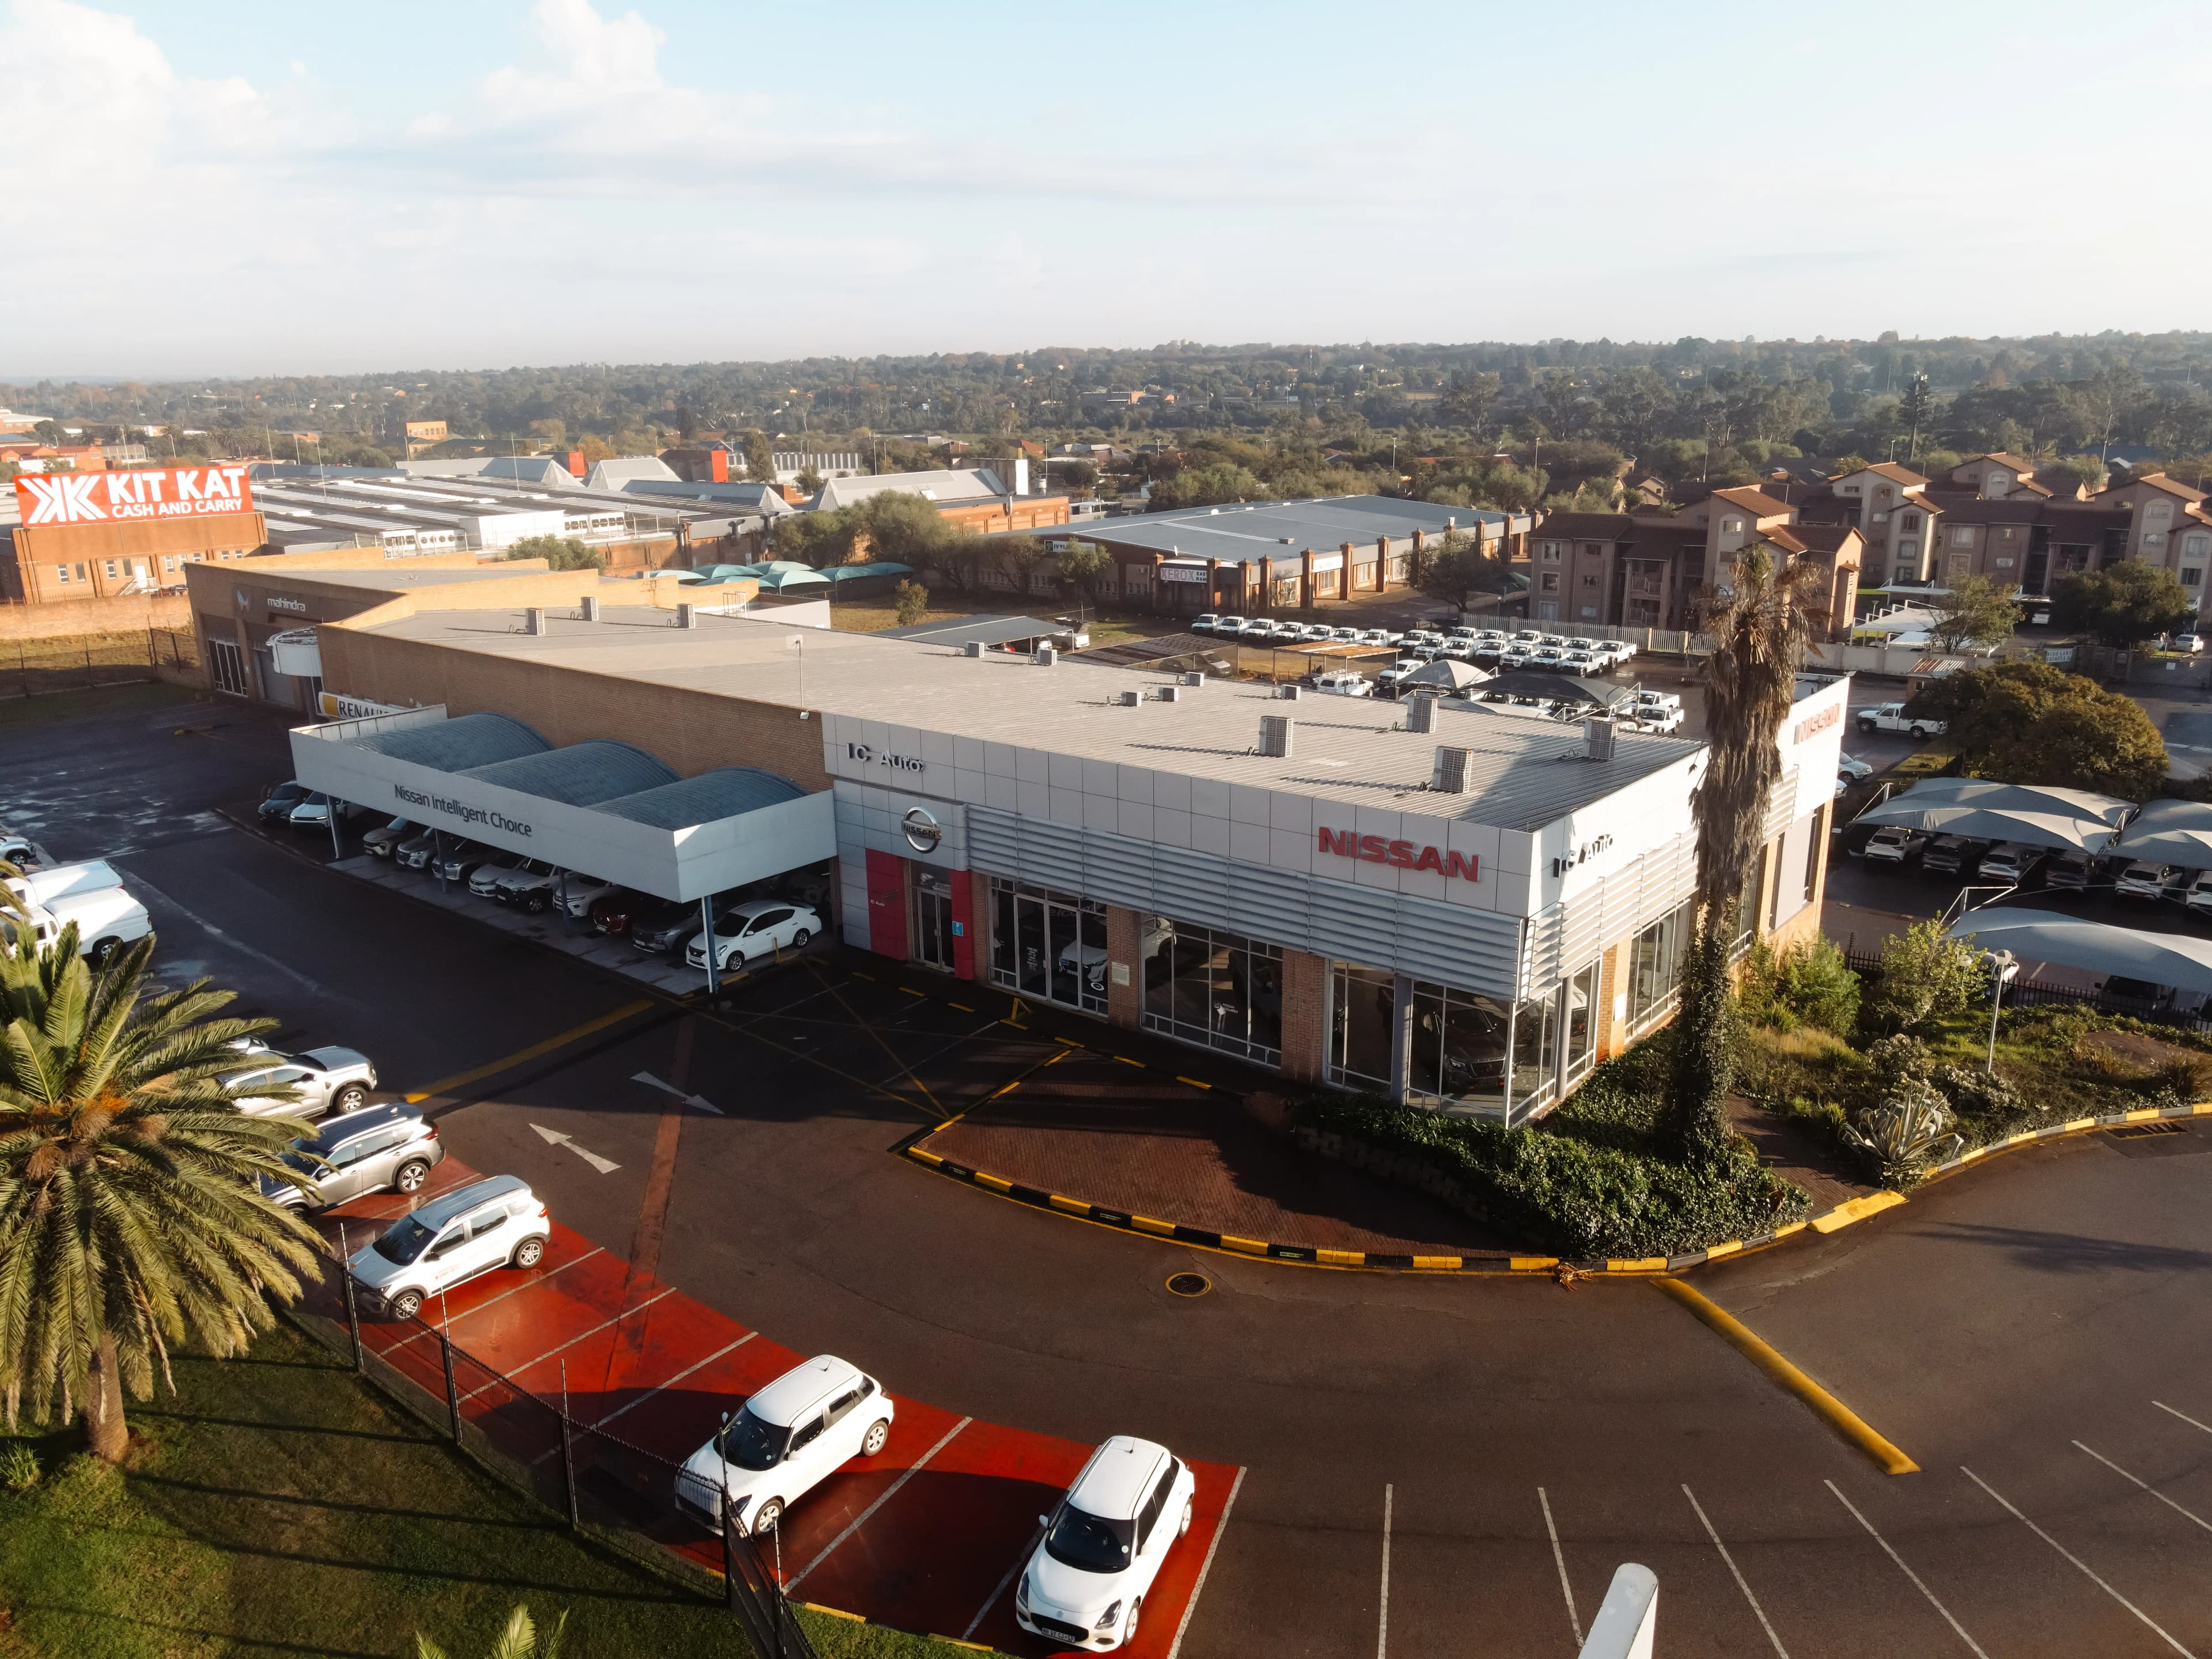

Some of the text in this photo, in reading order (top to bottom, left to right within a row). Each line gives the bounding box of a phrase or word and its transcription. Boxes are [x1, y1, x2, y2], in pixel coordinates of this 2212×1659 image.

[107, 468, 245, 504] KIT KAT
[112, 498, 243, 518] CASH AND CARRY
[1161, 568, 1194, 581] XEROX
[267, 598, 306, 612] mahindra
[1794, 703, 1840, 744] NISSAN
[847, 743, 924, 772] IC Auto
[395, 784, 532, 837] Nissan Intelligent Choice
[903, 824, 935, 838] NISSAN
[1319, 827, 1480, 882] NISSAN
